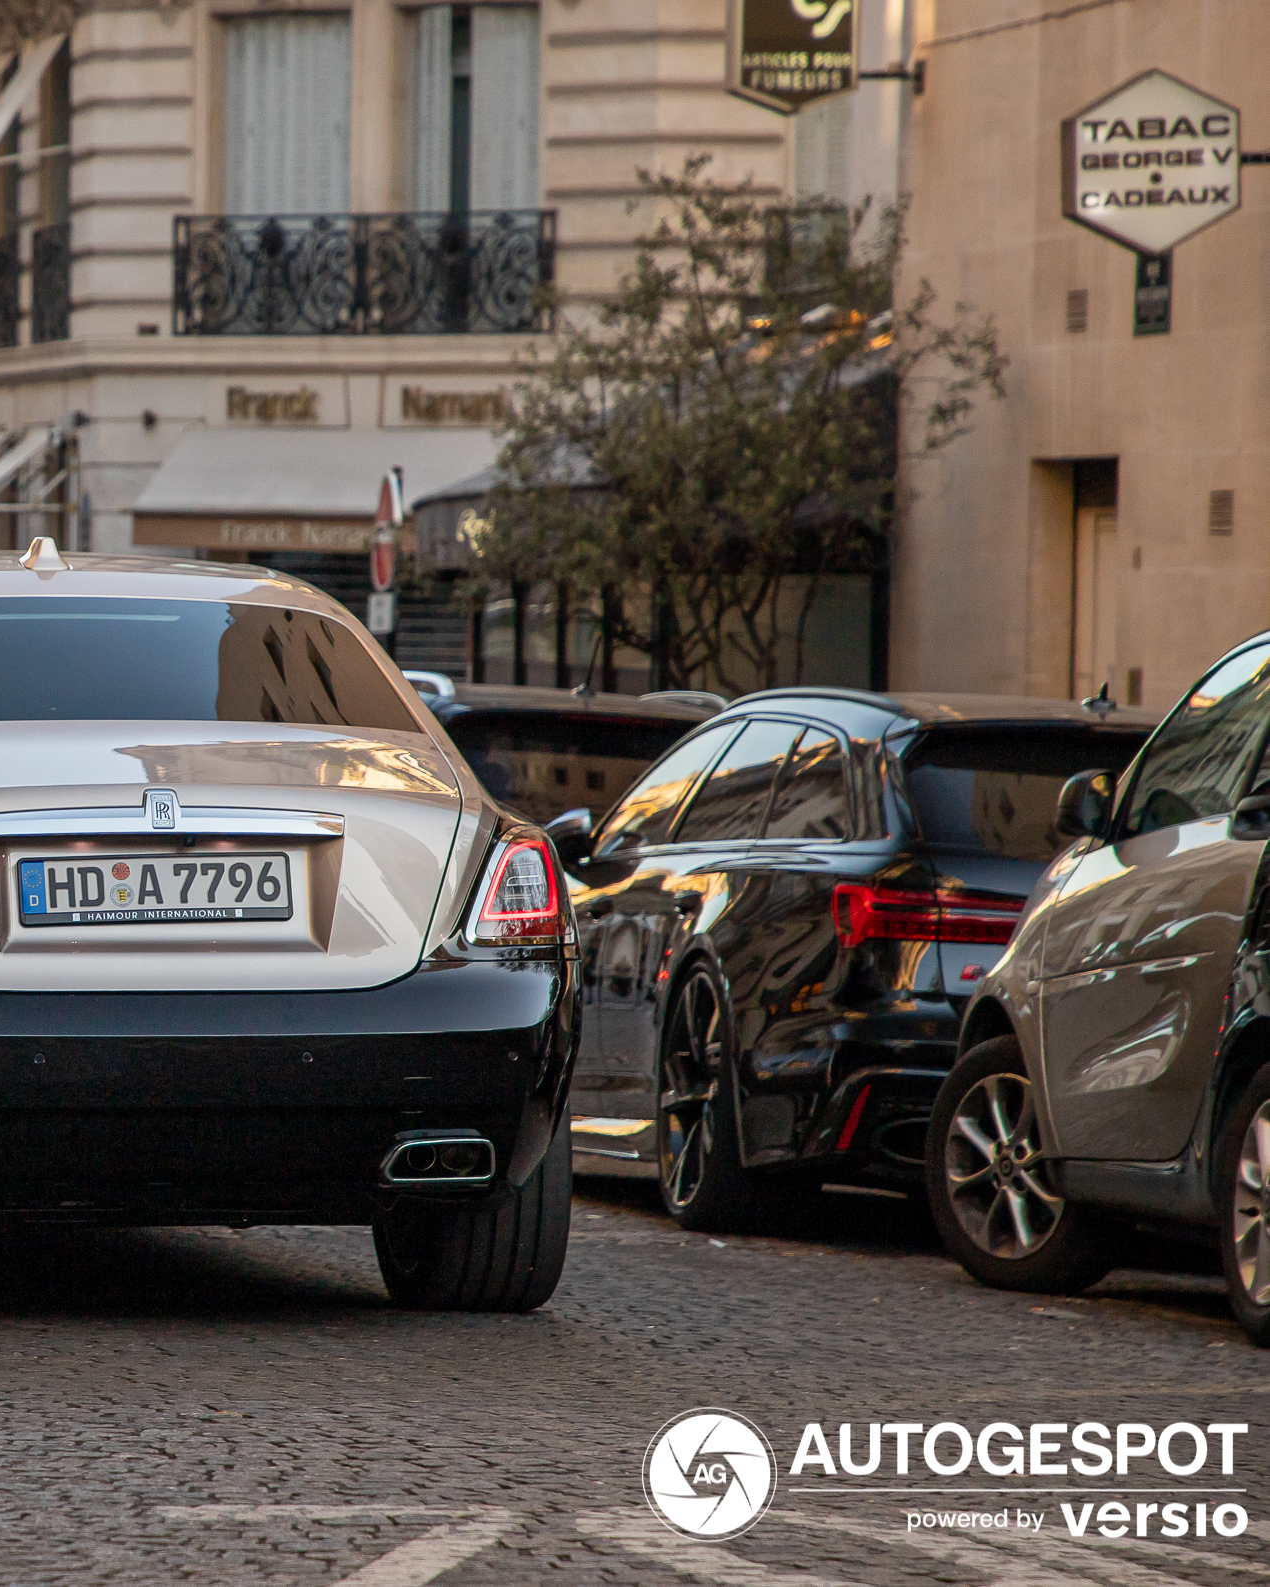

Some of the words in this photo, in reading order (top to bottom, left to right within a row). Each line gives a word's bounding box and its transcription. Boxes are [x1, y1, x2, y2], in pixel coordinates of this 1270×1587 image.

[750, 70, 842, 90] FUMEURS
[1082, 114, 1231, 142] TABAC
[1081, 149, 1204, 170] GEORGE
[1212, 147, 1232, 166] V
[1081, 184, 1230, 208] CADEAUX
[48, 866, 105, 909] HD
[137, 863, 164, 905] A
[173, 861, 281, 904] 7796
[29, 894, 39, 907] D
[87, 911, 138, 921] HAIMOUR
[144, 909, 228, 919] INTERNATIONAL
